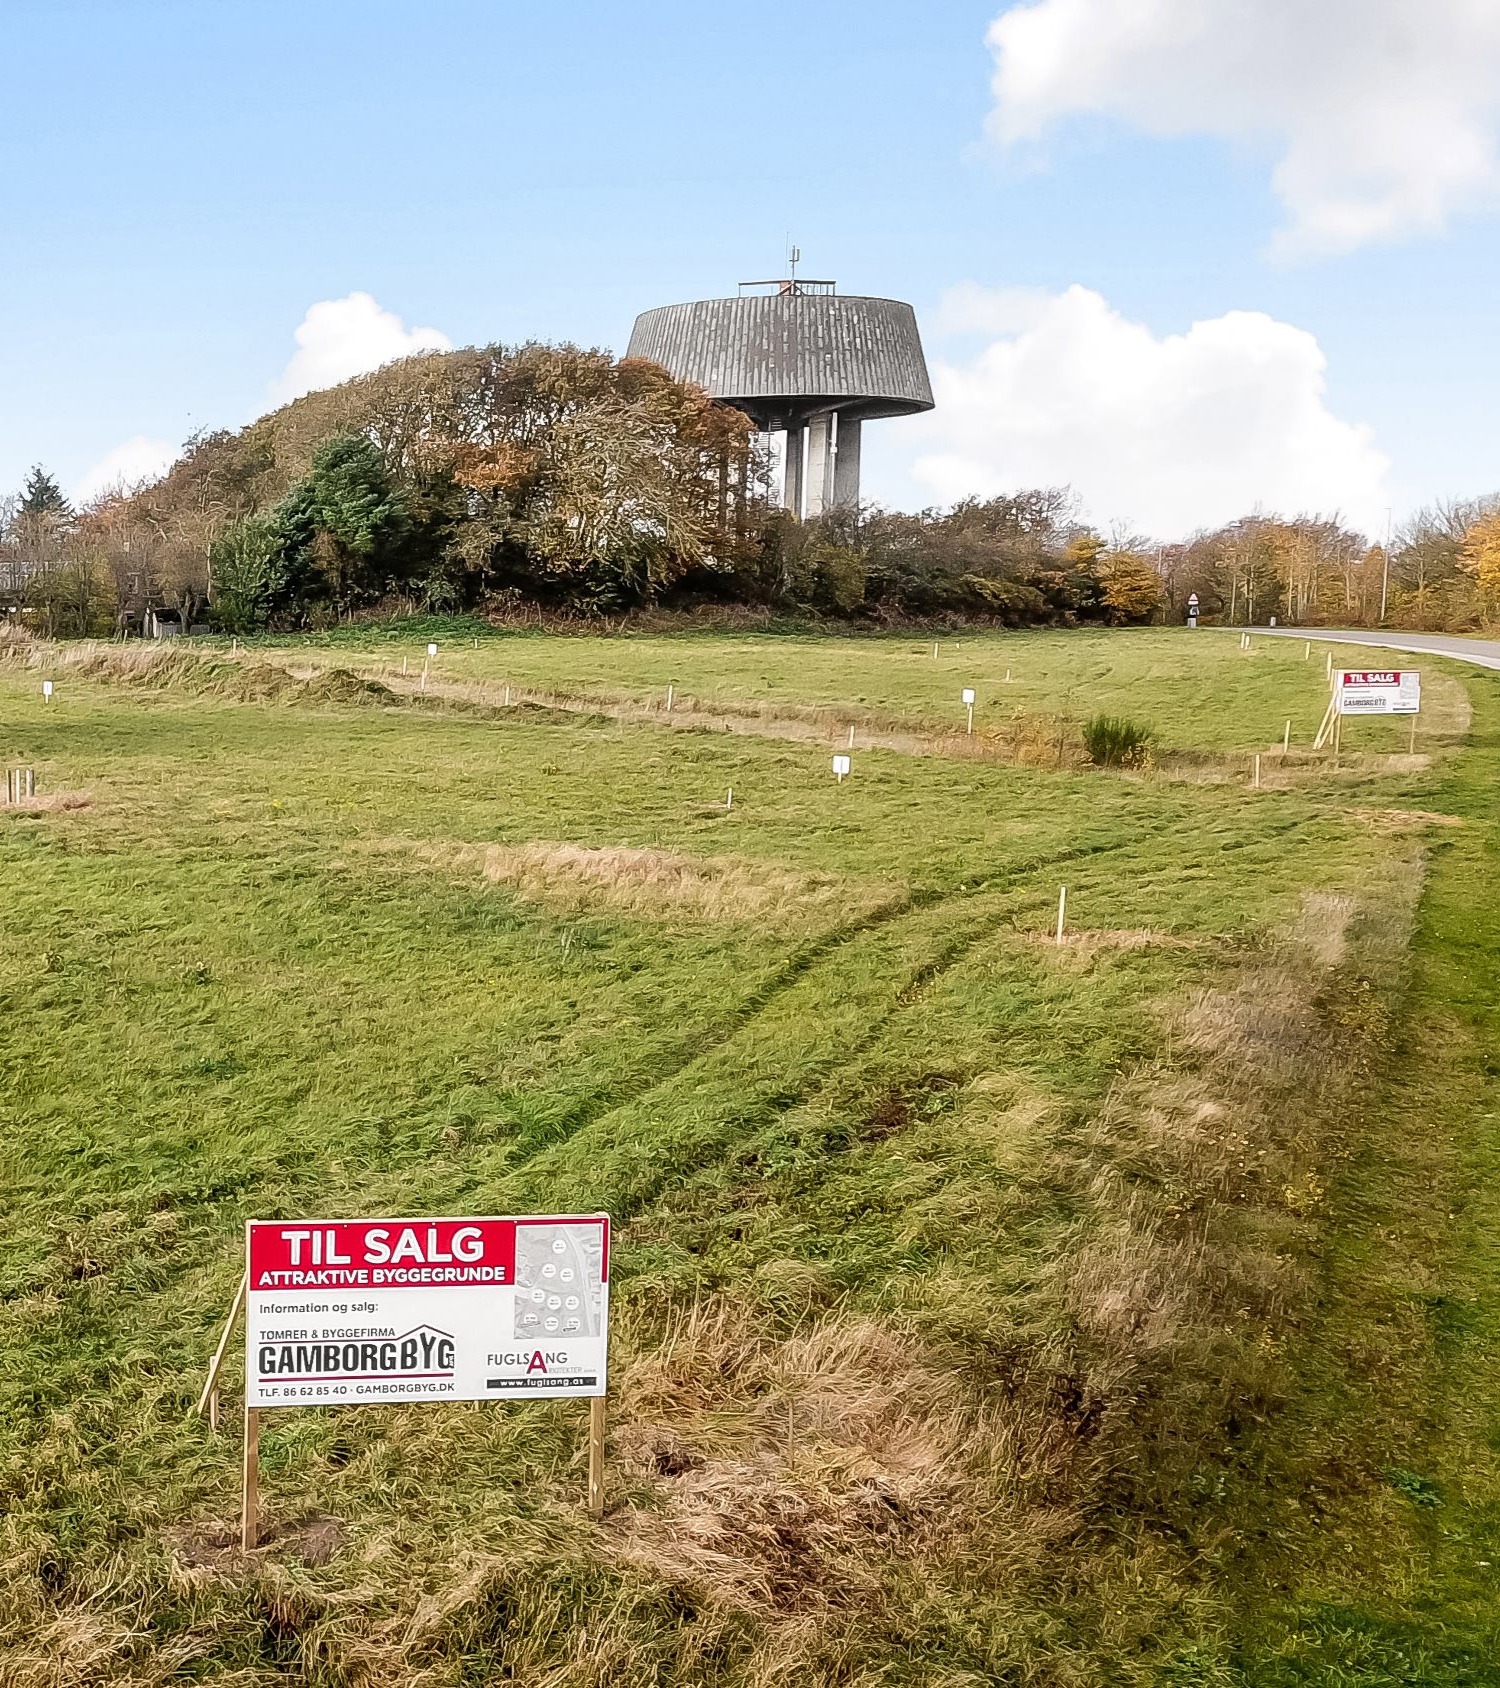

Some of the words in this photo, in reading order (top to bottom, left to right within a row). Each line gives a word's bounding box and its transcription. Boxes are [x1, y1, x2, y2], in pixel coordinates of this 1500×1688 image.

[1349, 674, 1366, 682] TIL
[1367, 674, 1394, 682] SALG
[281, 1229, 351, 1265] TIL
[364, 1226, 484, 1264] SALG
[259, 1269, 369, 1286] ATTRAKTIVE
[372, 1266, 506, 1284] BYGGEGRUNDE
[259, 1303, 329, 1314] Information
[332, 1304, 348, 1314] og
[351, 1302, 379, 1314] salg:
[259, 1329, 308, 1341] TØMRER
[311, 1329, 319, 1339] &
[322, 1328, 396, 1339] BYGGEFIRMA
[487, 1350, 568, 1374] FUGLSANG
[258, 1388, 280, 1397] TLF.
[283, 1387, 297, 1396] 86
[299, 1386, 313, 1396] 62
[316, 1386, 330, 1396] 85
[332, 1385, 348, 1395] 40
[356, 1383, 455, 1395] GAMBORGBYG.DK
